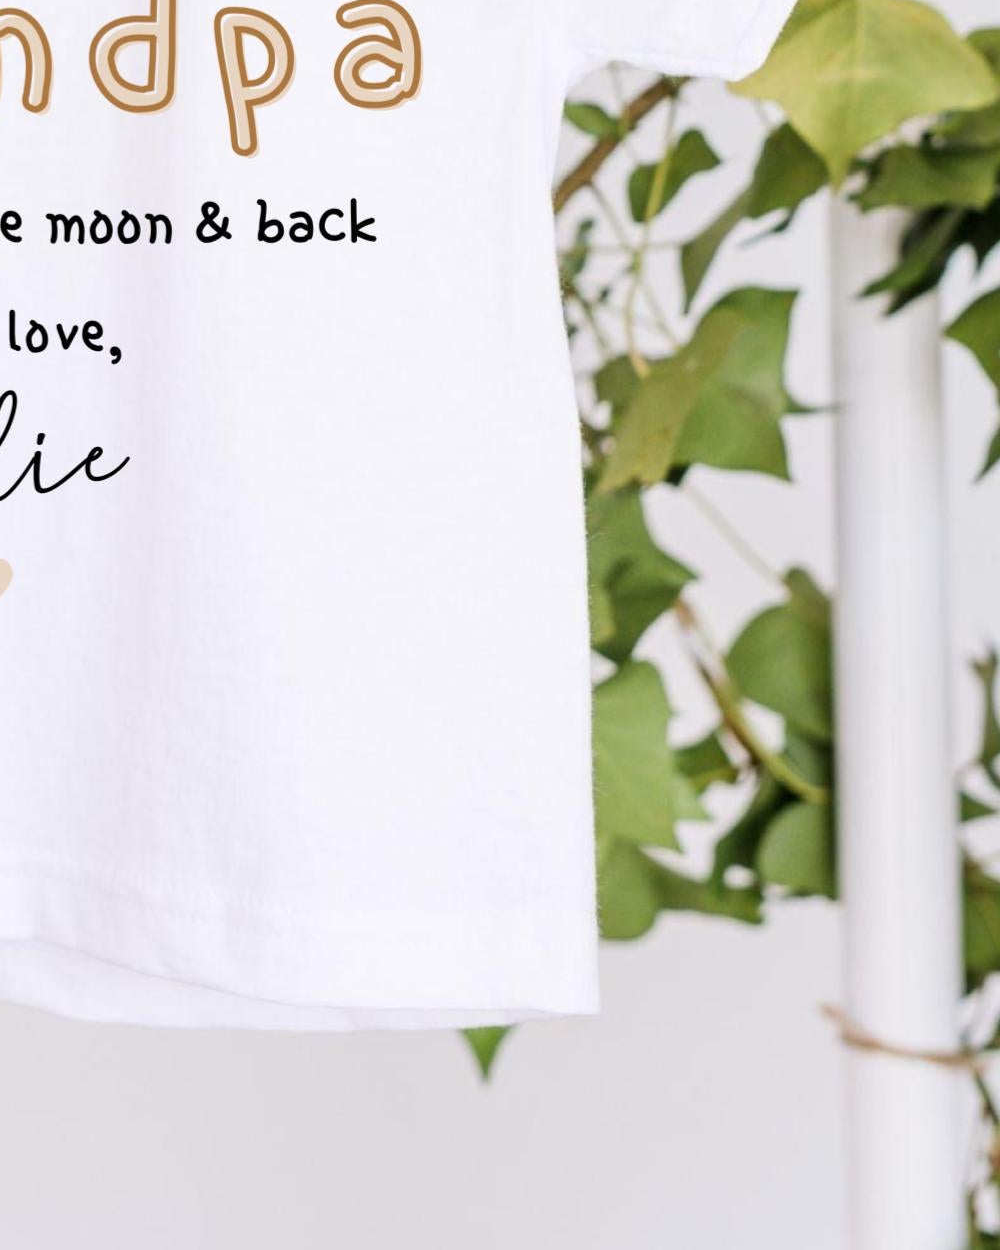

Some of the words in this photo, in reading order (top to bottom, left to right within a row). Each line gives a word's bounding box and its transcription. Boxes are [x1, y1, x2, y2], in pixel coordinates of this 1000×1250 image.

[46, 211, 172, 244] moon
[196, 201, 232, 243] &
[257, 198, 377, 243] back
[9, 310, 121, 364] love,
